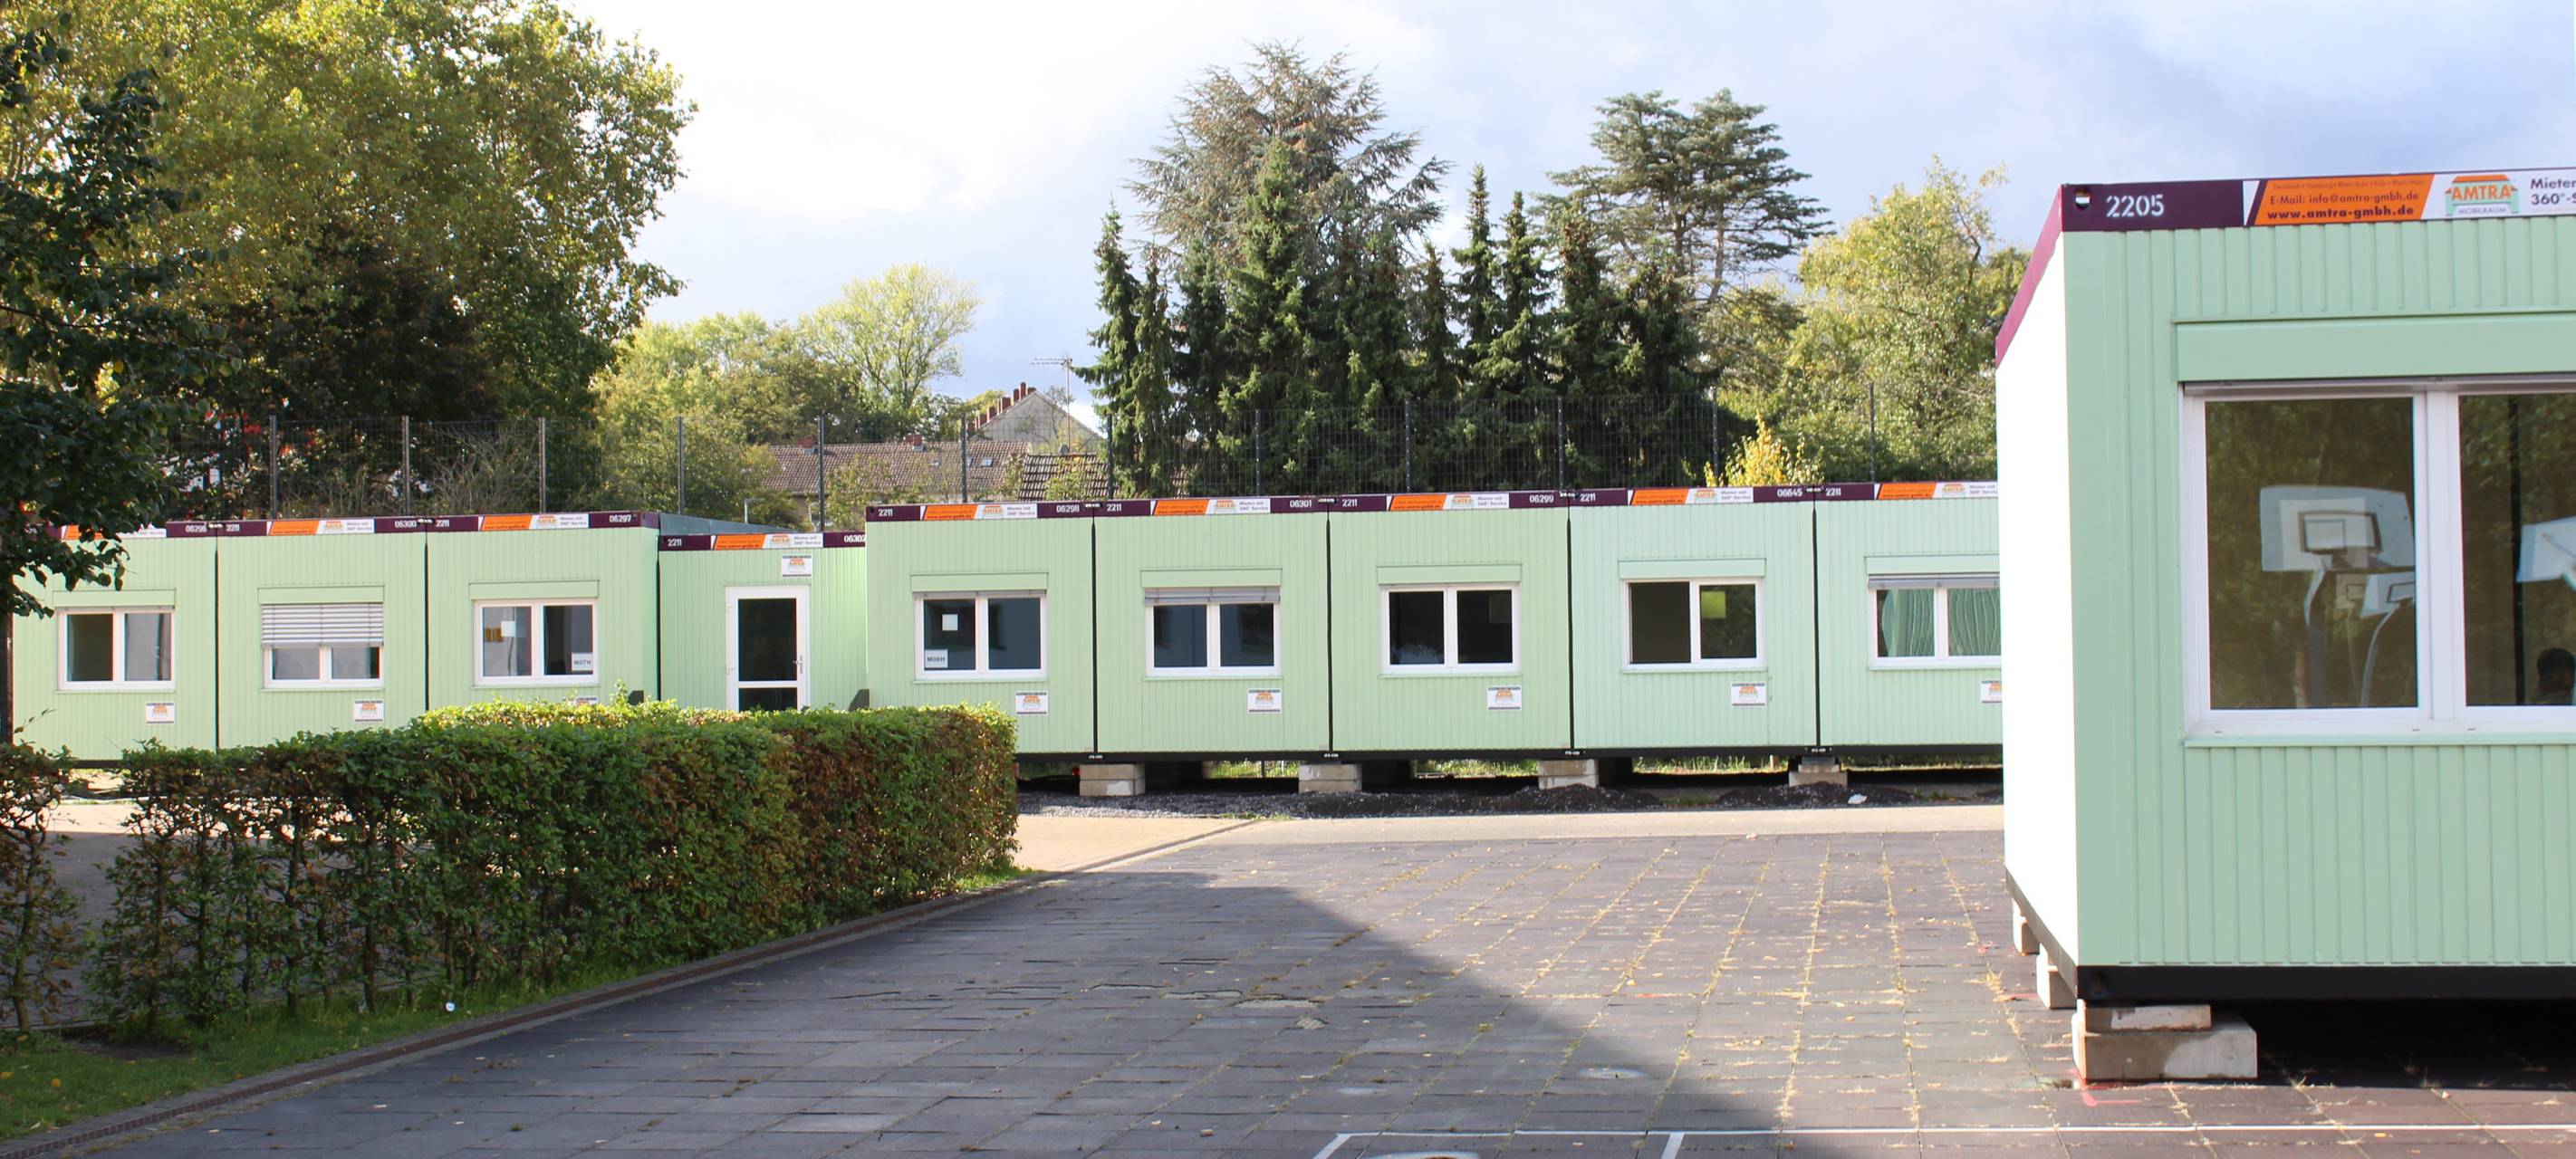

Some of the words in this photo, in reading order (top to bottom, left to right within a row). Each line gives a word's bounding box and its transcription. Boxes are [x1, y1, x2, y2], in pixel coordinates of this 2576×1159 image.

[2451, 184, 2512, 202] AMTRA
[2270, 195, 2305, 205] E-Mail:
[2309, 191, 2419, 204] info@amtra-gmbh.de
[2106, 194, 2165, 217] 2205
[2267, 205, 2414, 219] www.amtra-gmbh.de
[1825, 487, 1841, 496] 2211
[1580, 493, 1596, 502] 2211
[1289, 499, 1312, 508] 06301
[1341, 498, 1358, 507] 2211
[1106, 503, 1122, 512] 2211
[878, 508, 893, 517] 2211
[609, 514, 631, 523] 06297
[668, 538, 682, 547] 2211
